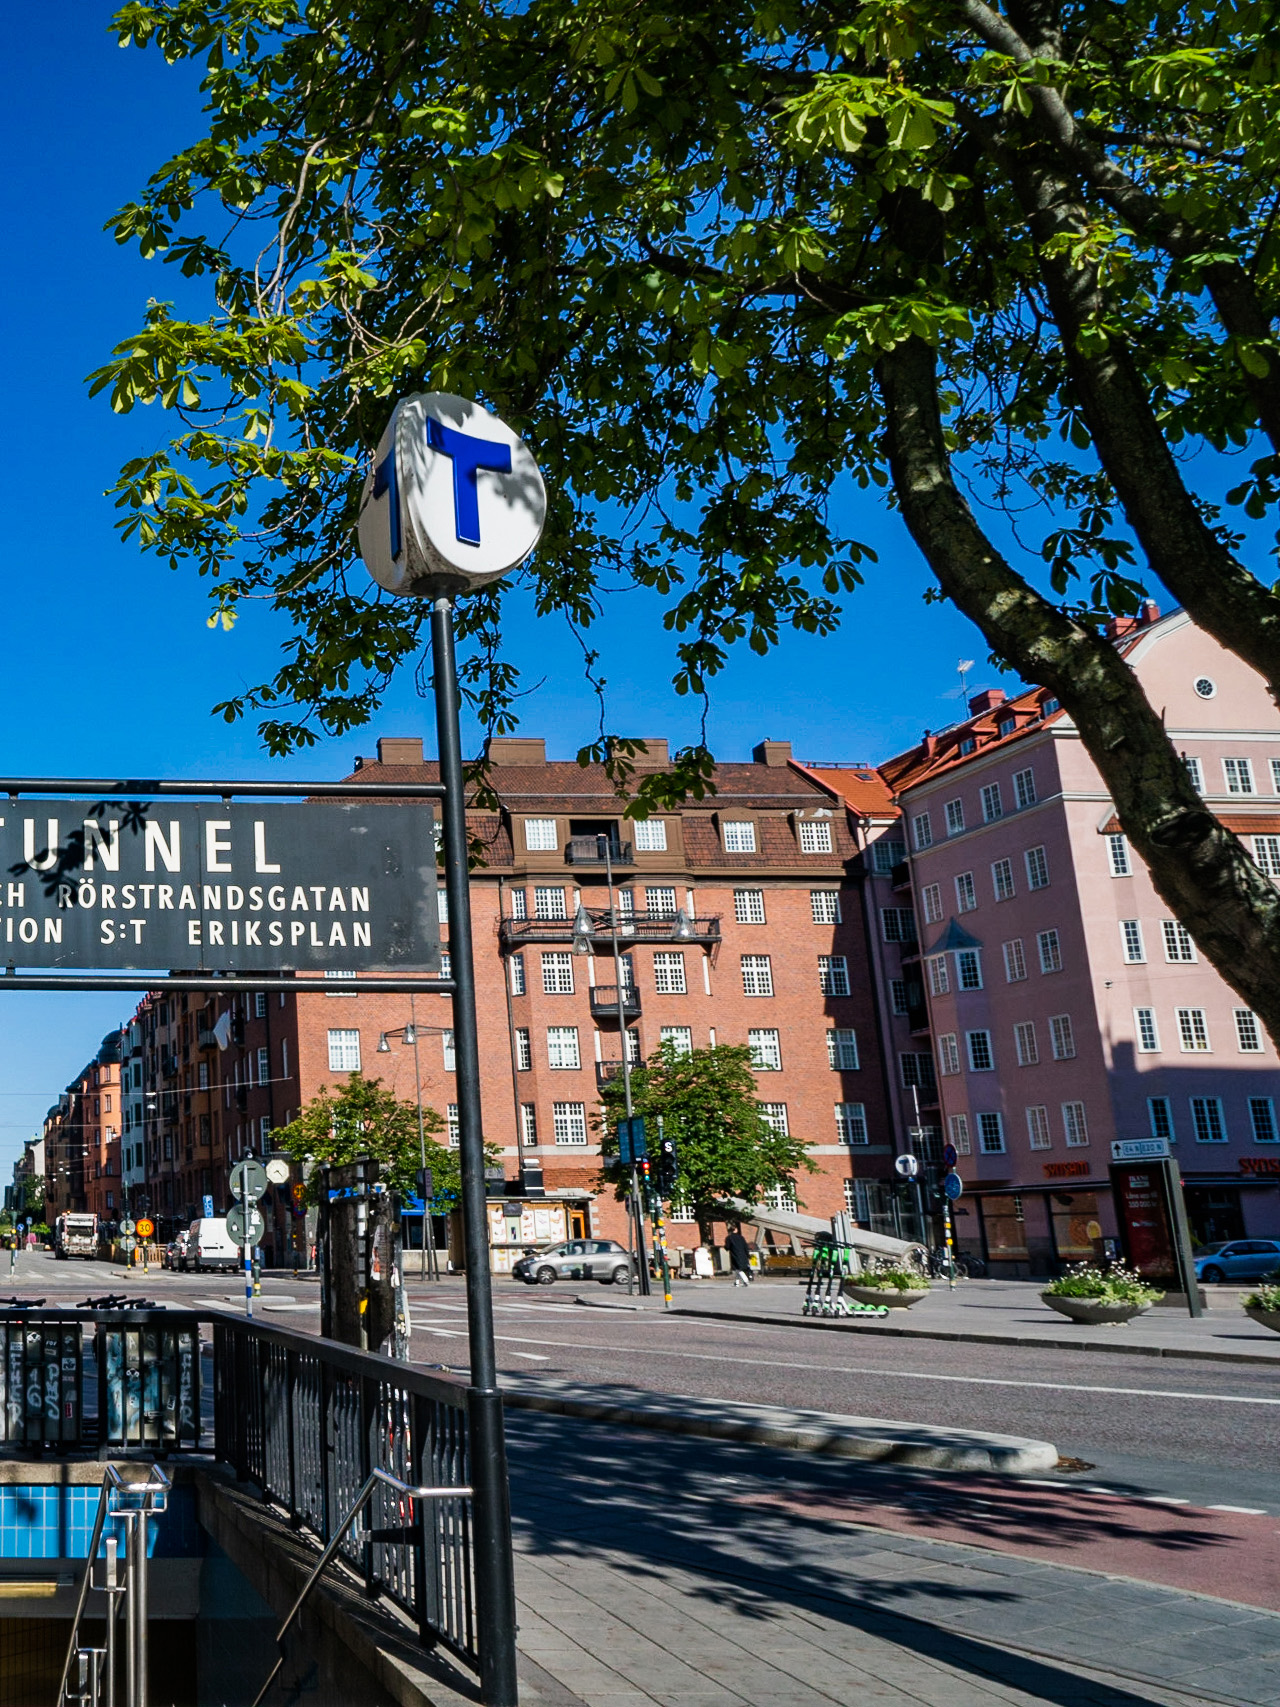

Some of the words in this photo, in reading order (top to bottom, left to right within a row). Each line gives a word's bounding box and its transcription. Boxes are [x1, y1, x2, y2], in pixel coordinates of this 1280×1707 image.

[426, 415, 512, 548] T
[58, 877, 370, 912] RÖRSTRANDSGATAN
[100, 918, 147, 945] S:T
[187, 919, 372, 947] ERIKSPLAN
[139, 1224, 150, 1233] 30
